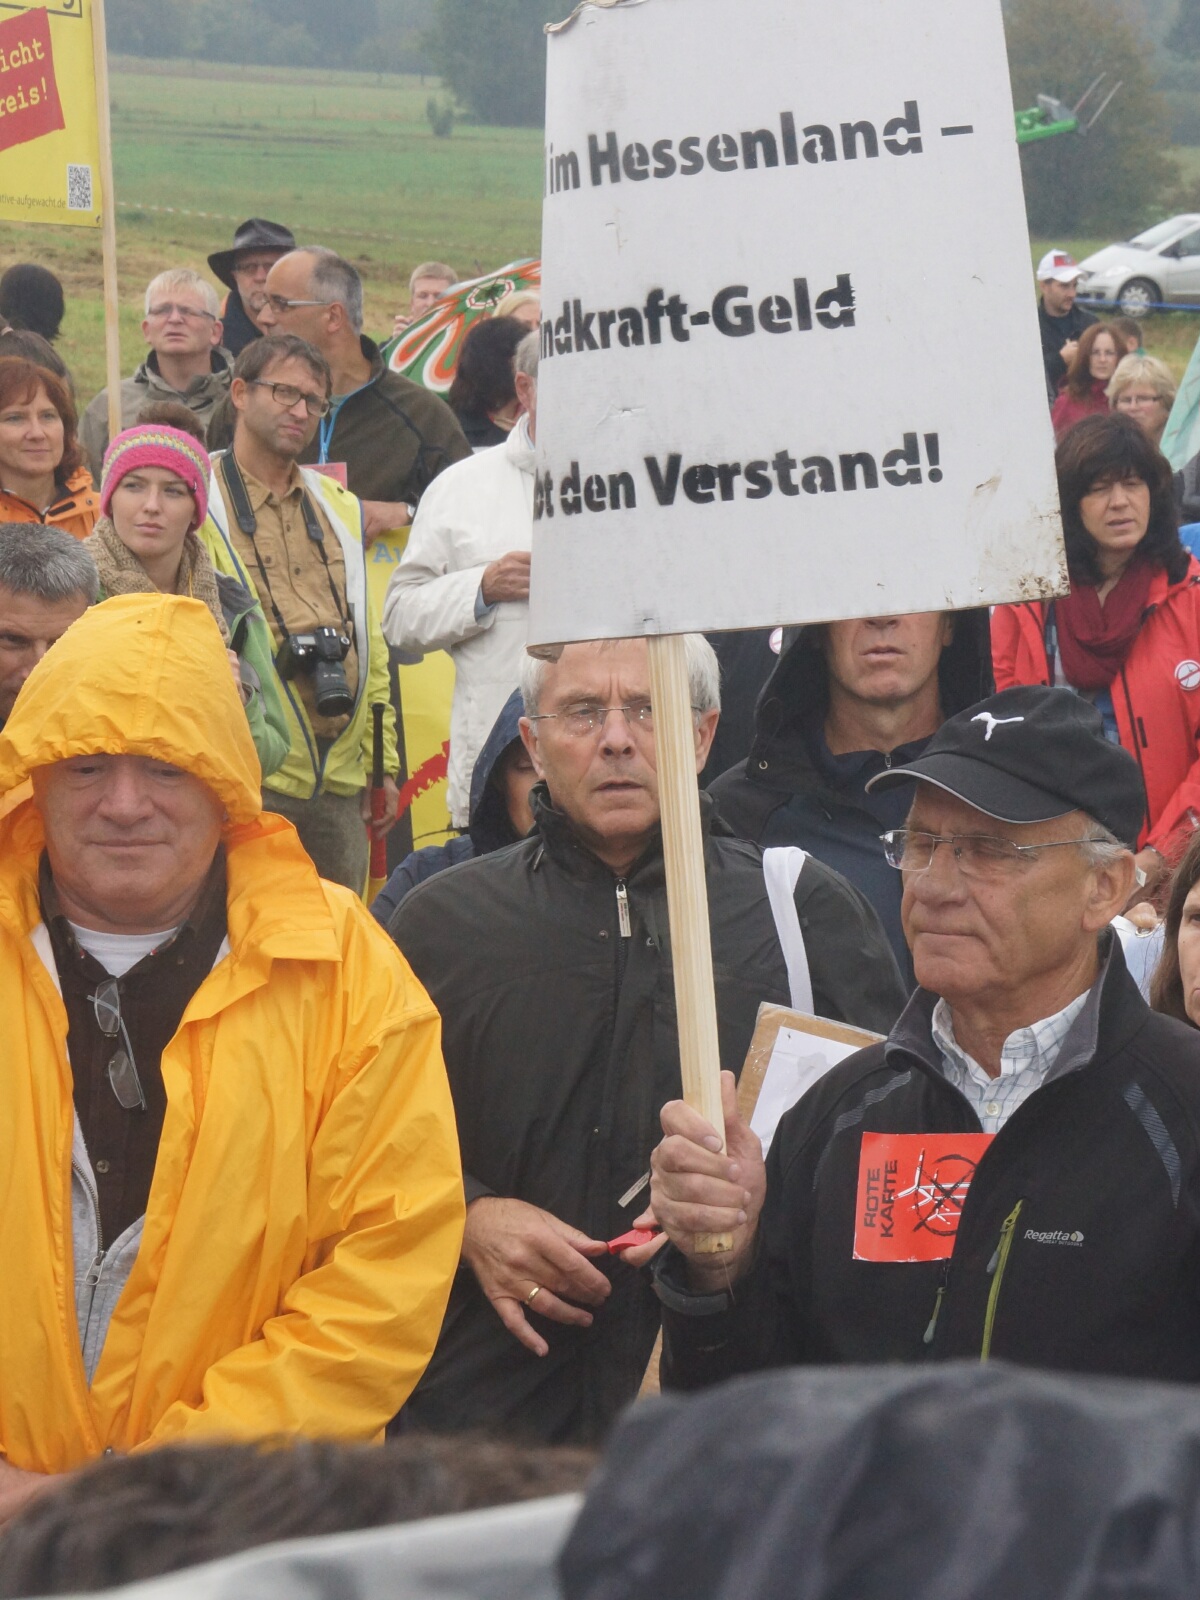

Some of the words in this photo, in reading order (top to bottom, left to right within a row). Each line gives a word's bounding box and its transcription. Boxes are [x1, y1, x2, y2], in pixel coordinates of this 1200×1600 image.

[550, 142, 581, 195] im
[587, 100, 924, 187] Hessenland
[560, 461, 636, 516] den
[643, 432, 943, 506] Verstand!
[863, 1168, 881, 1228] ROTE
[880, 1159, 898, 1238] KARTE
[1023, 1229, 1070, 1242] Regatta
